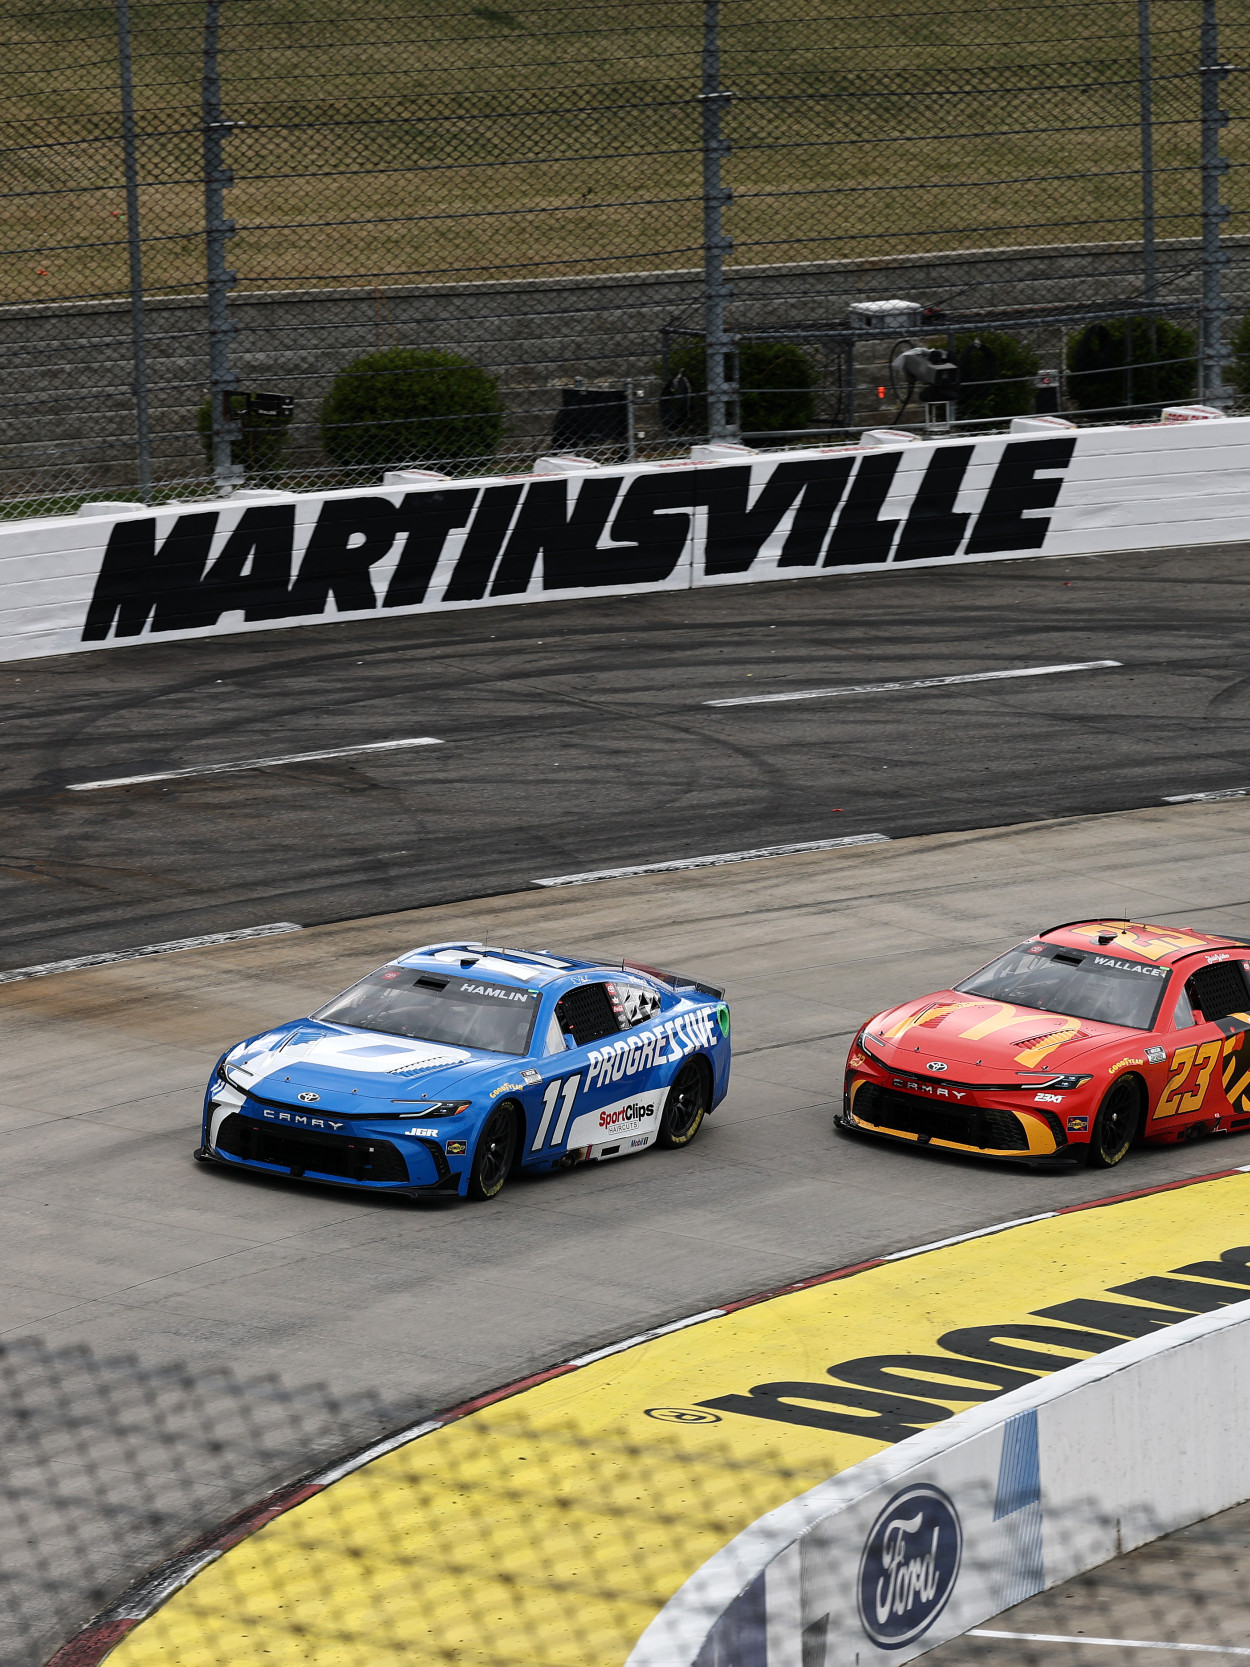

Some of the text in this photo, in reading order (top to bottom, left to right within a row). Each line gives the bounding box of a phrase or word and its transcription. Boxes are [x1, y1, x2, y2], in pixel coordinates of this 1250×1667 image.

[81, 438, 1077, 642] MARTINSVILLE
[1094, 956, 1161, 977] WALLACE
[460, 983, 528, 1003] HAMLIN
[584, 1007, 719, 1093] PROGRESSIVE
[1108, 1058, 1144, 1075] GOODYEAR
[1152, 1039, 1222, 1120] 23
[489, 1082, 524, 1099] GOODYEAR
[531, 1072, 583, 1153] 11
[404, 1128, 439, 1138] JGR
[608, 1121, 638, 1134] HAIRCUTS
[630, 1138, 644, 1148] Mobil
[876, 1512, 940, 1624] Ford
